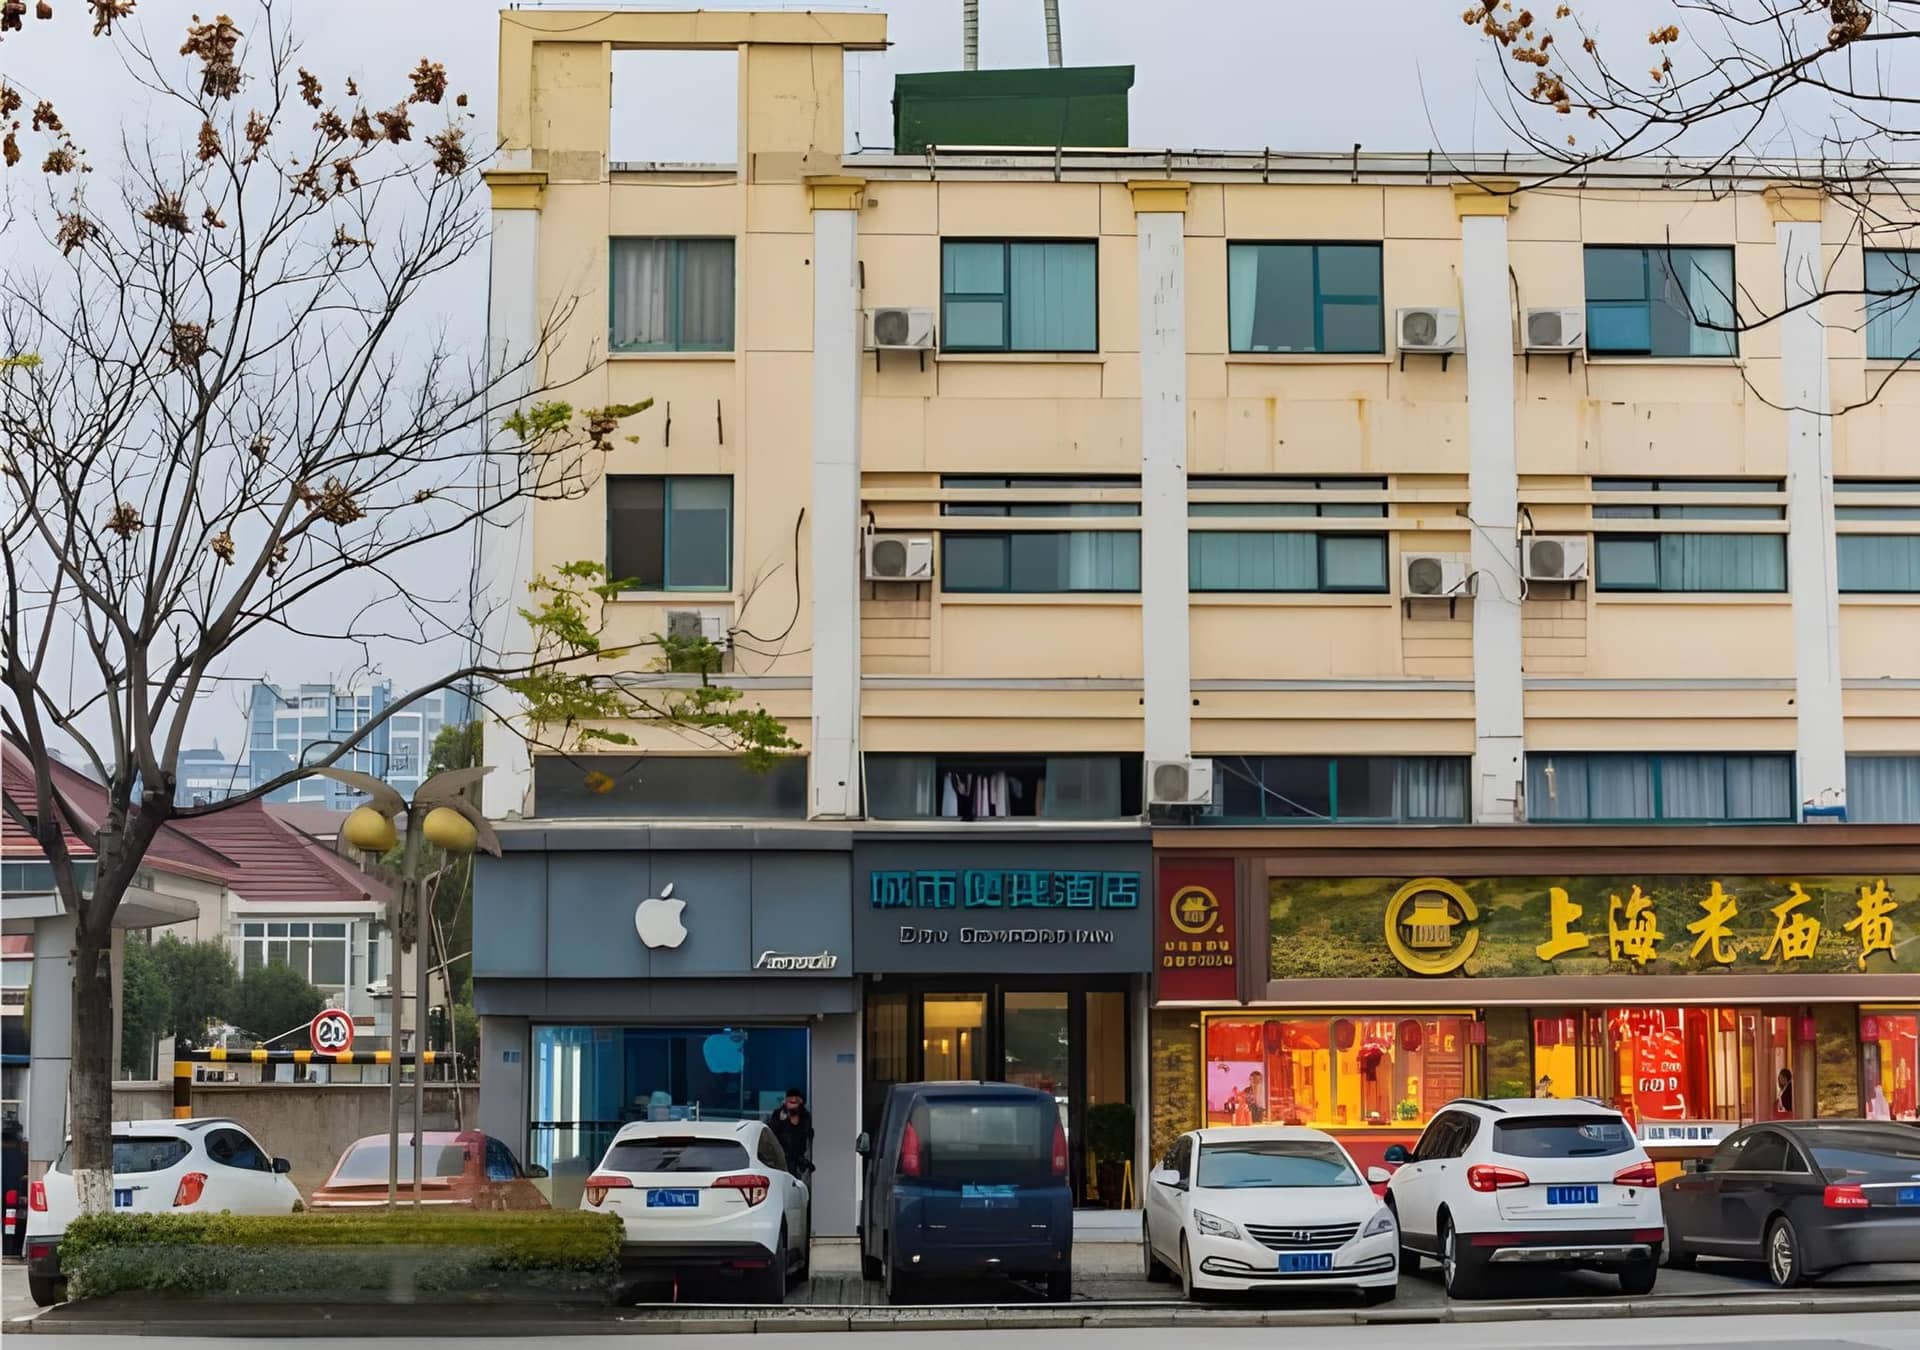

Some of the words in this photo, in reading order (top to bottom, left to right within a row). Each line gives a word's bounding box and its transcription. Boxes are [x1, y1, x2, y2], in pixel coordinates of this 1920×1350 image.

[1536, 880, 1898, 972] 上海老庙黄
